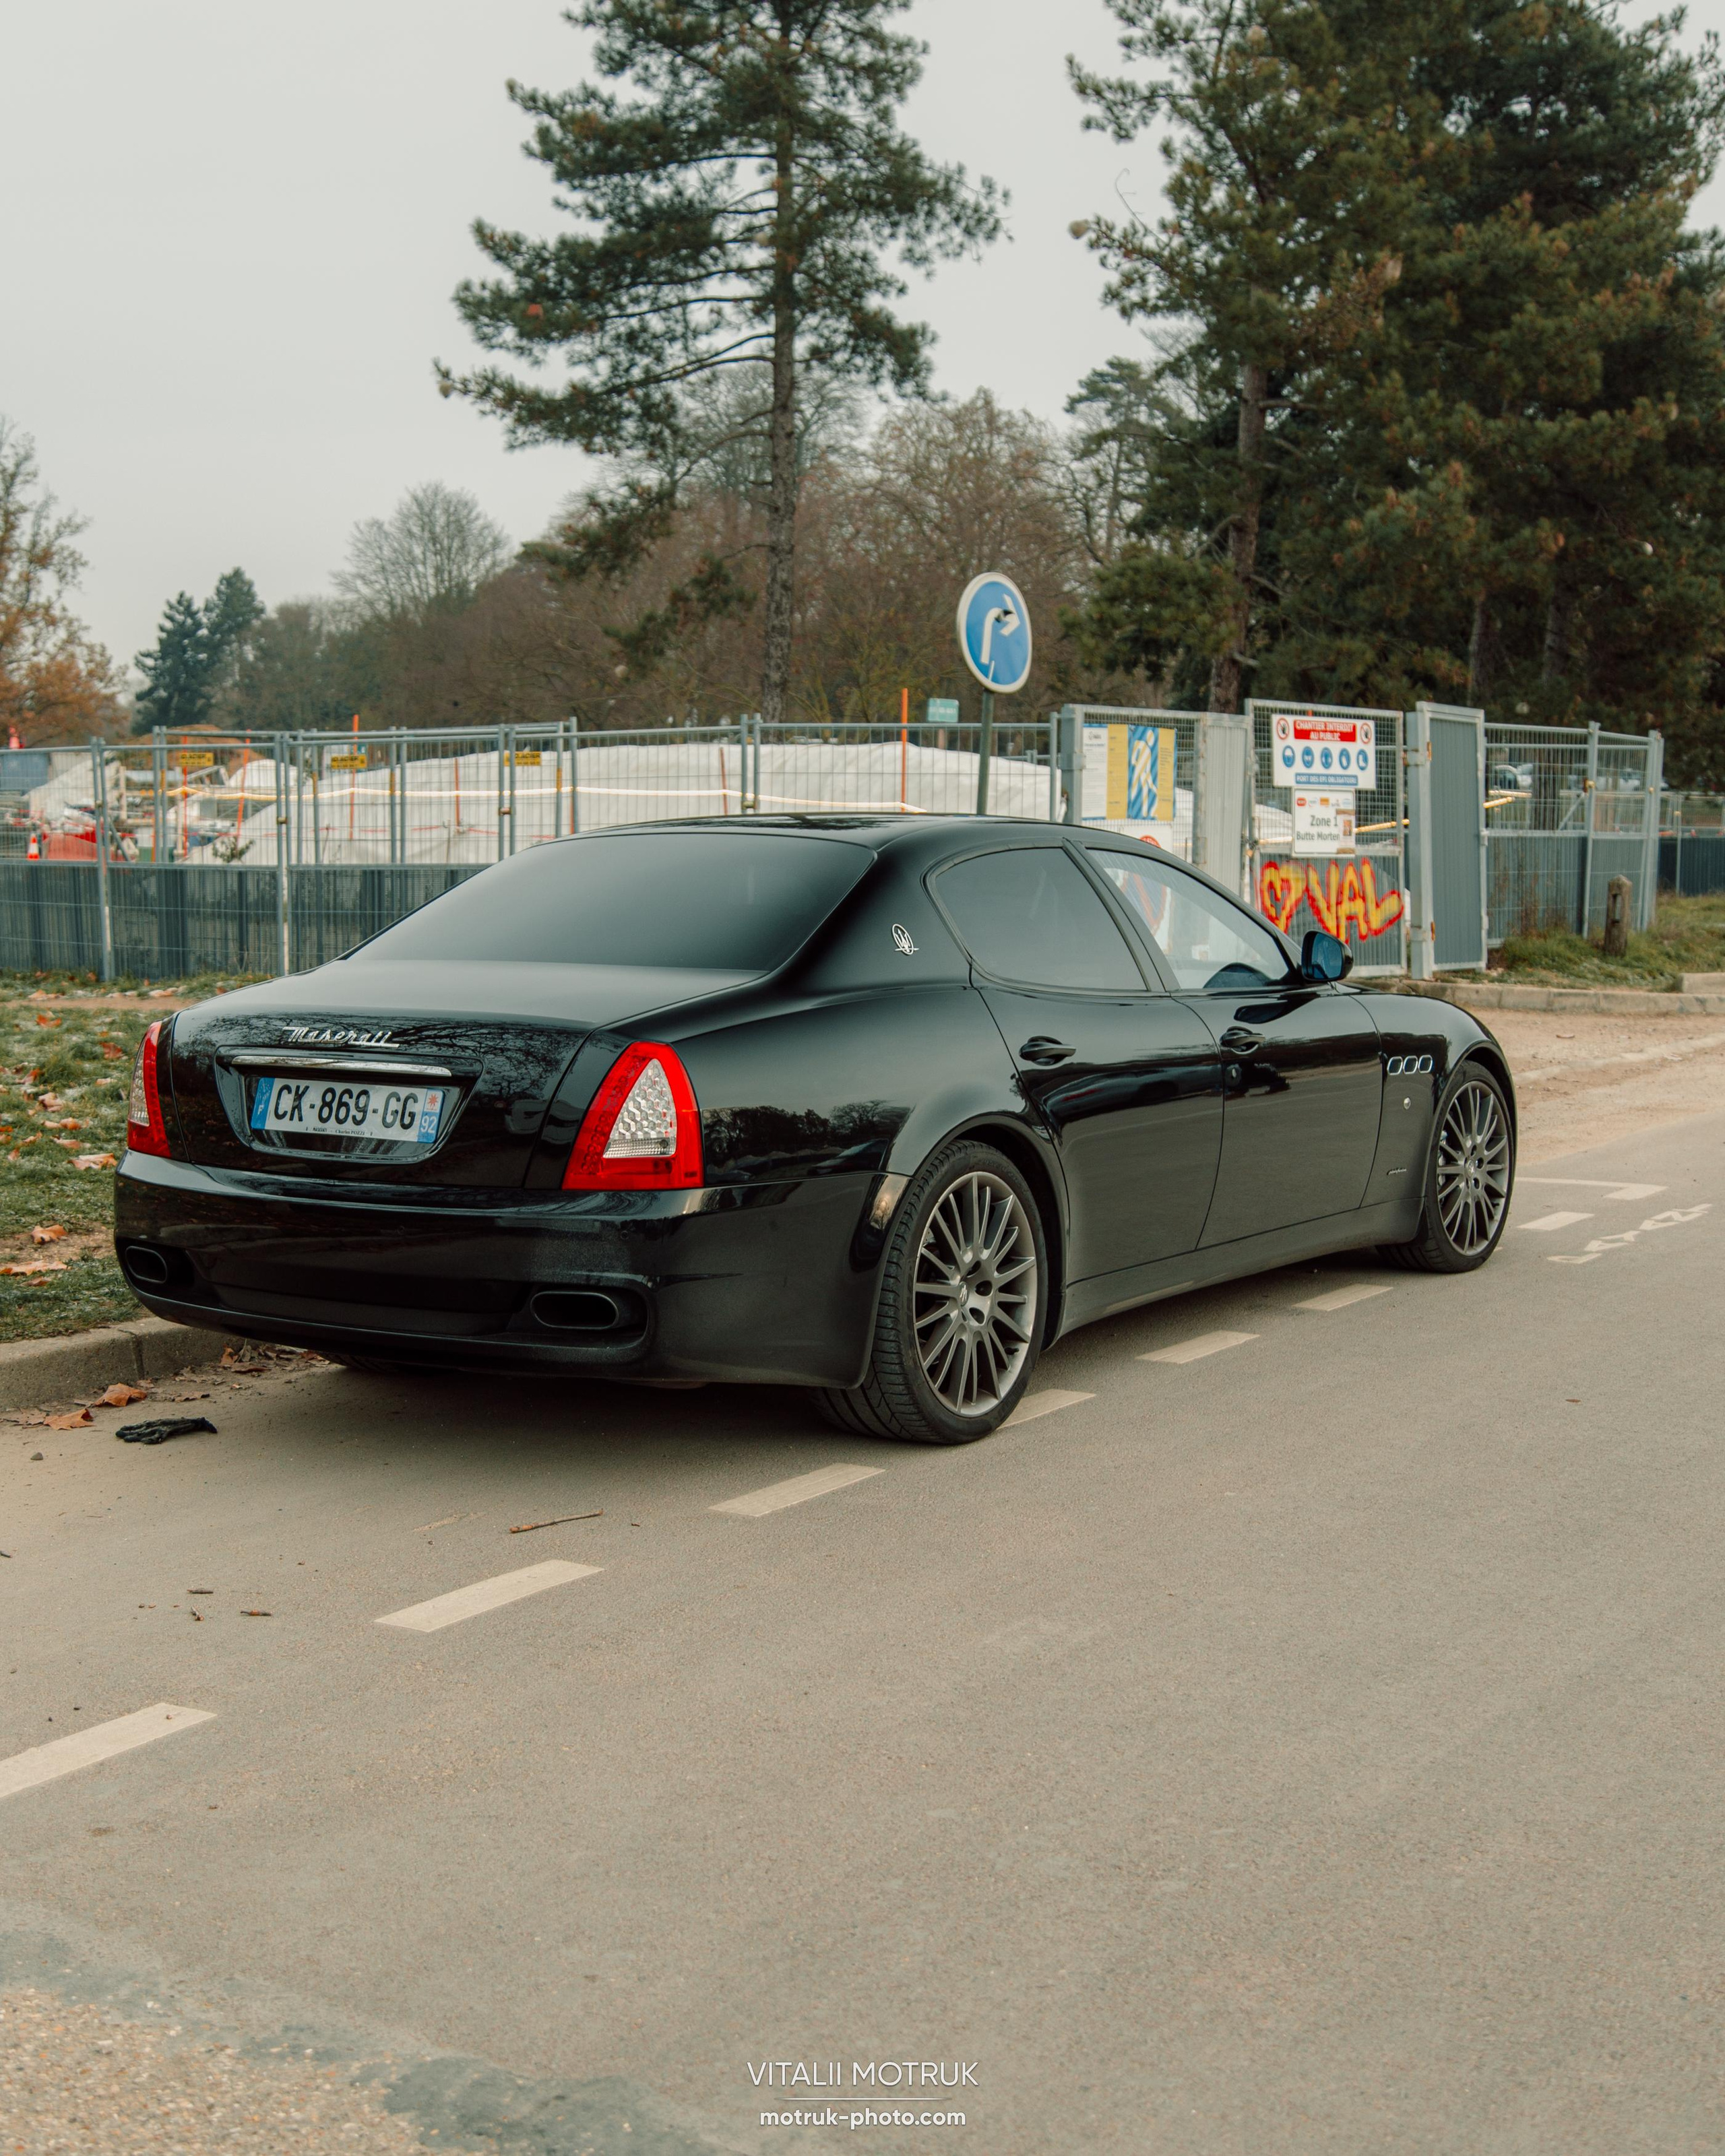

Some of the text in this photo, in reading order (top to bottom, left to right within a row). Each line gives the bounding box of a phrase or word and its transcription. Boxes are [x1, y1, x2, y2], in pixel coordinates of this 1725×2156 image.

[1295, 720, 1354, 732] CHANTIER INTERDIT
[1320, 732, 1341, 740] PUBLIC
[1311, 815, 1338, 827] Zone 1
[1296, 831, 1315, 840] Butte
[282, 1026, 400, 1048] Maserati
[257, 1104, 265, 1115] F
[274, 1083, 418, 1130] CK-869-GG
[420, 1116, 437, 1133] 92
